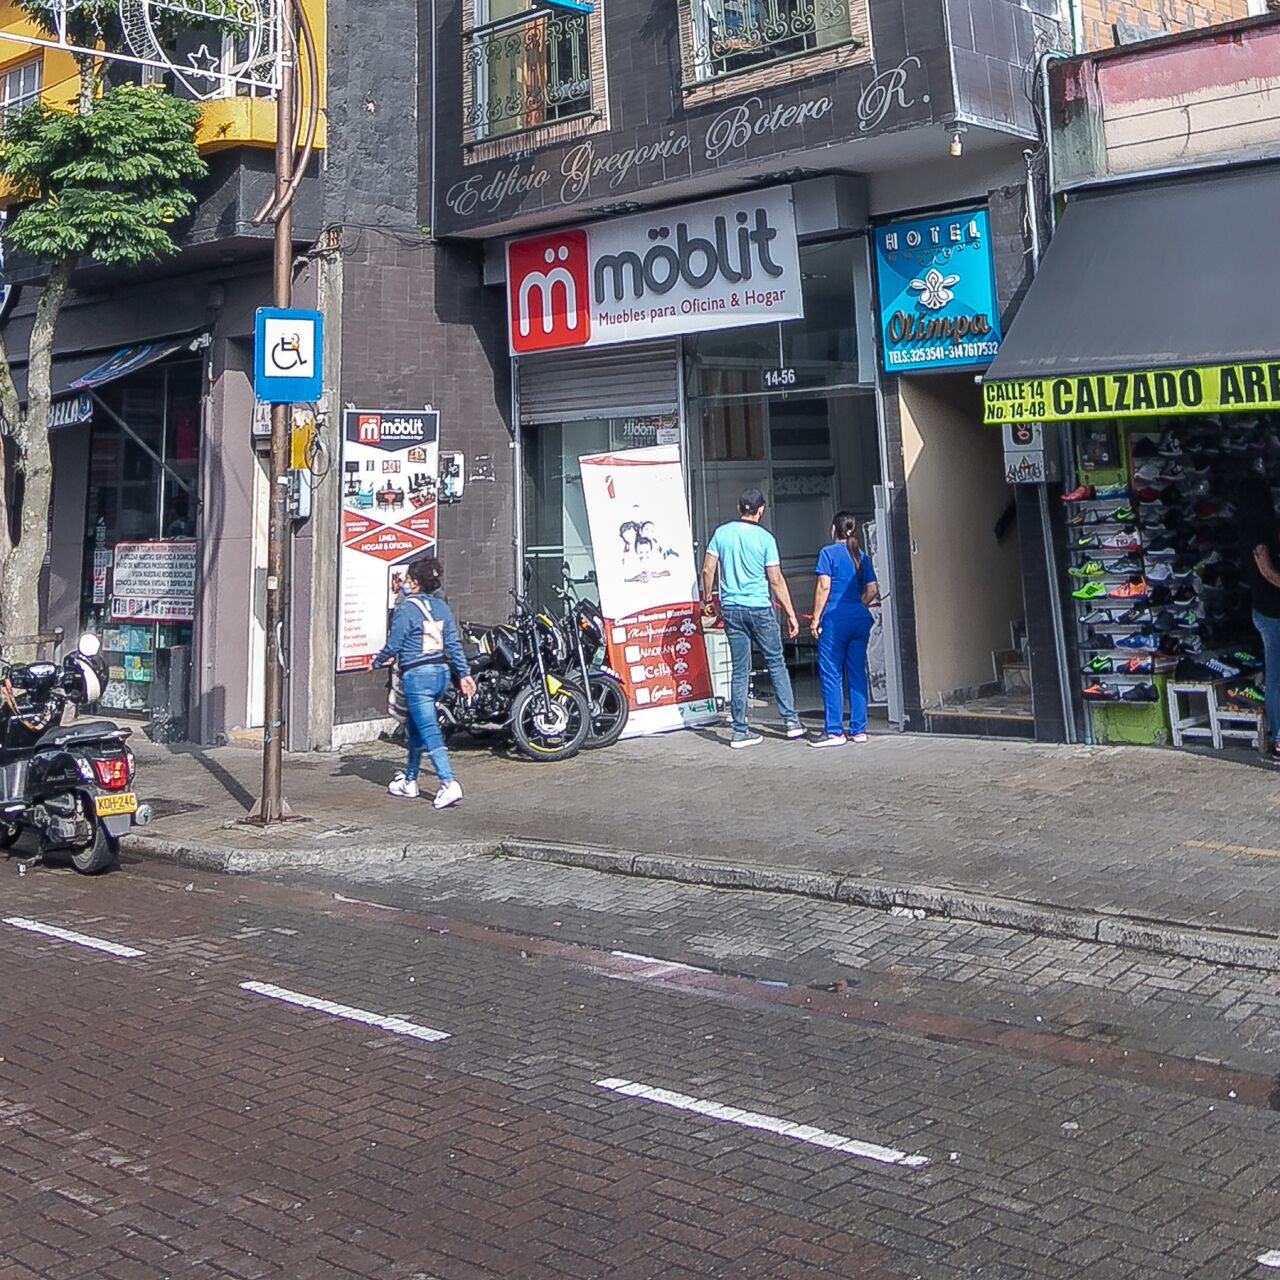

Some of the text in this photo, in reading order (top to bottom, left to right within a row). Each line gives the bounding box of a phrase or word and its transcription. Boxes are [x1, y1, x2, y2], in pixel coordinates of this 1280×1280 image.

[446, 163, 550, 217] Edificio
[560, 130, 689, 206] Gregorio
[705, 92, 832, 160] Botero
[885, 219, 982, 250] HOTEL
[594, 208, 784, 304] möblit
[599, 289, 786, 326] Muebles para Oficina & Hogar
[986, 381, 1044, 401] CALLE 14
[1052, 370, 1203, 415] CALZADO
[381, 418, 424, 434] möblit
[987, 401, 1046, 420] No. 14-48
